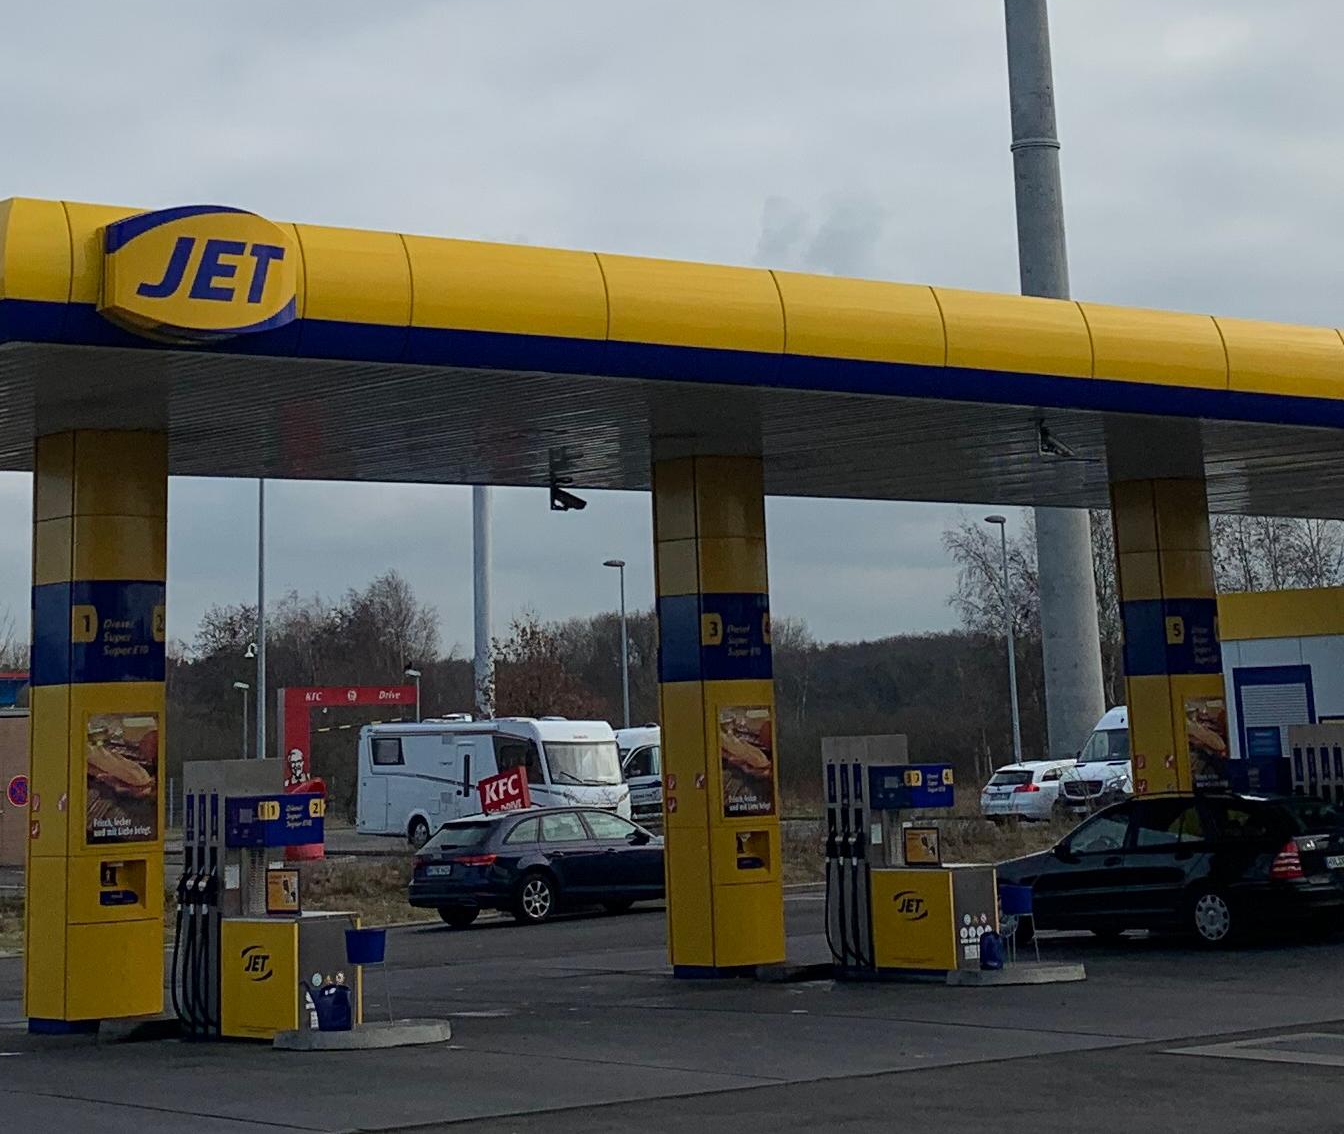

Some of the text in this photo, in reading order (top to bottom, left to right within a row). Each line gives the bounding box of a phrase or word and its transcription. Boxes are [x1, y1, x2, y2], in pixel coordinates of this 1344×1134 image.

[136, 237, 285, 304] JET
[485, 774, 520, 805] KFC
[897, 897, 924, 914] JET
[244, 954, 271, 973] JET
